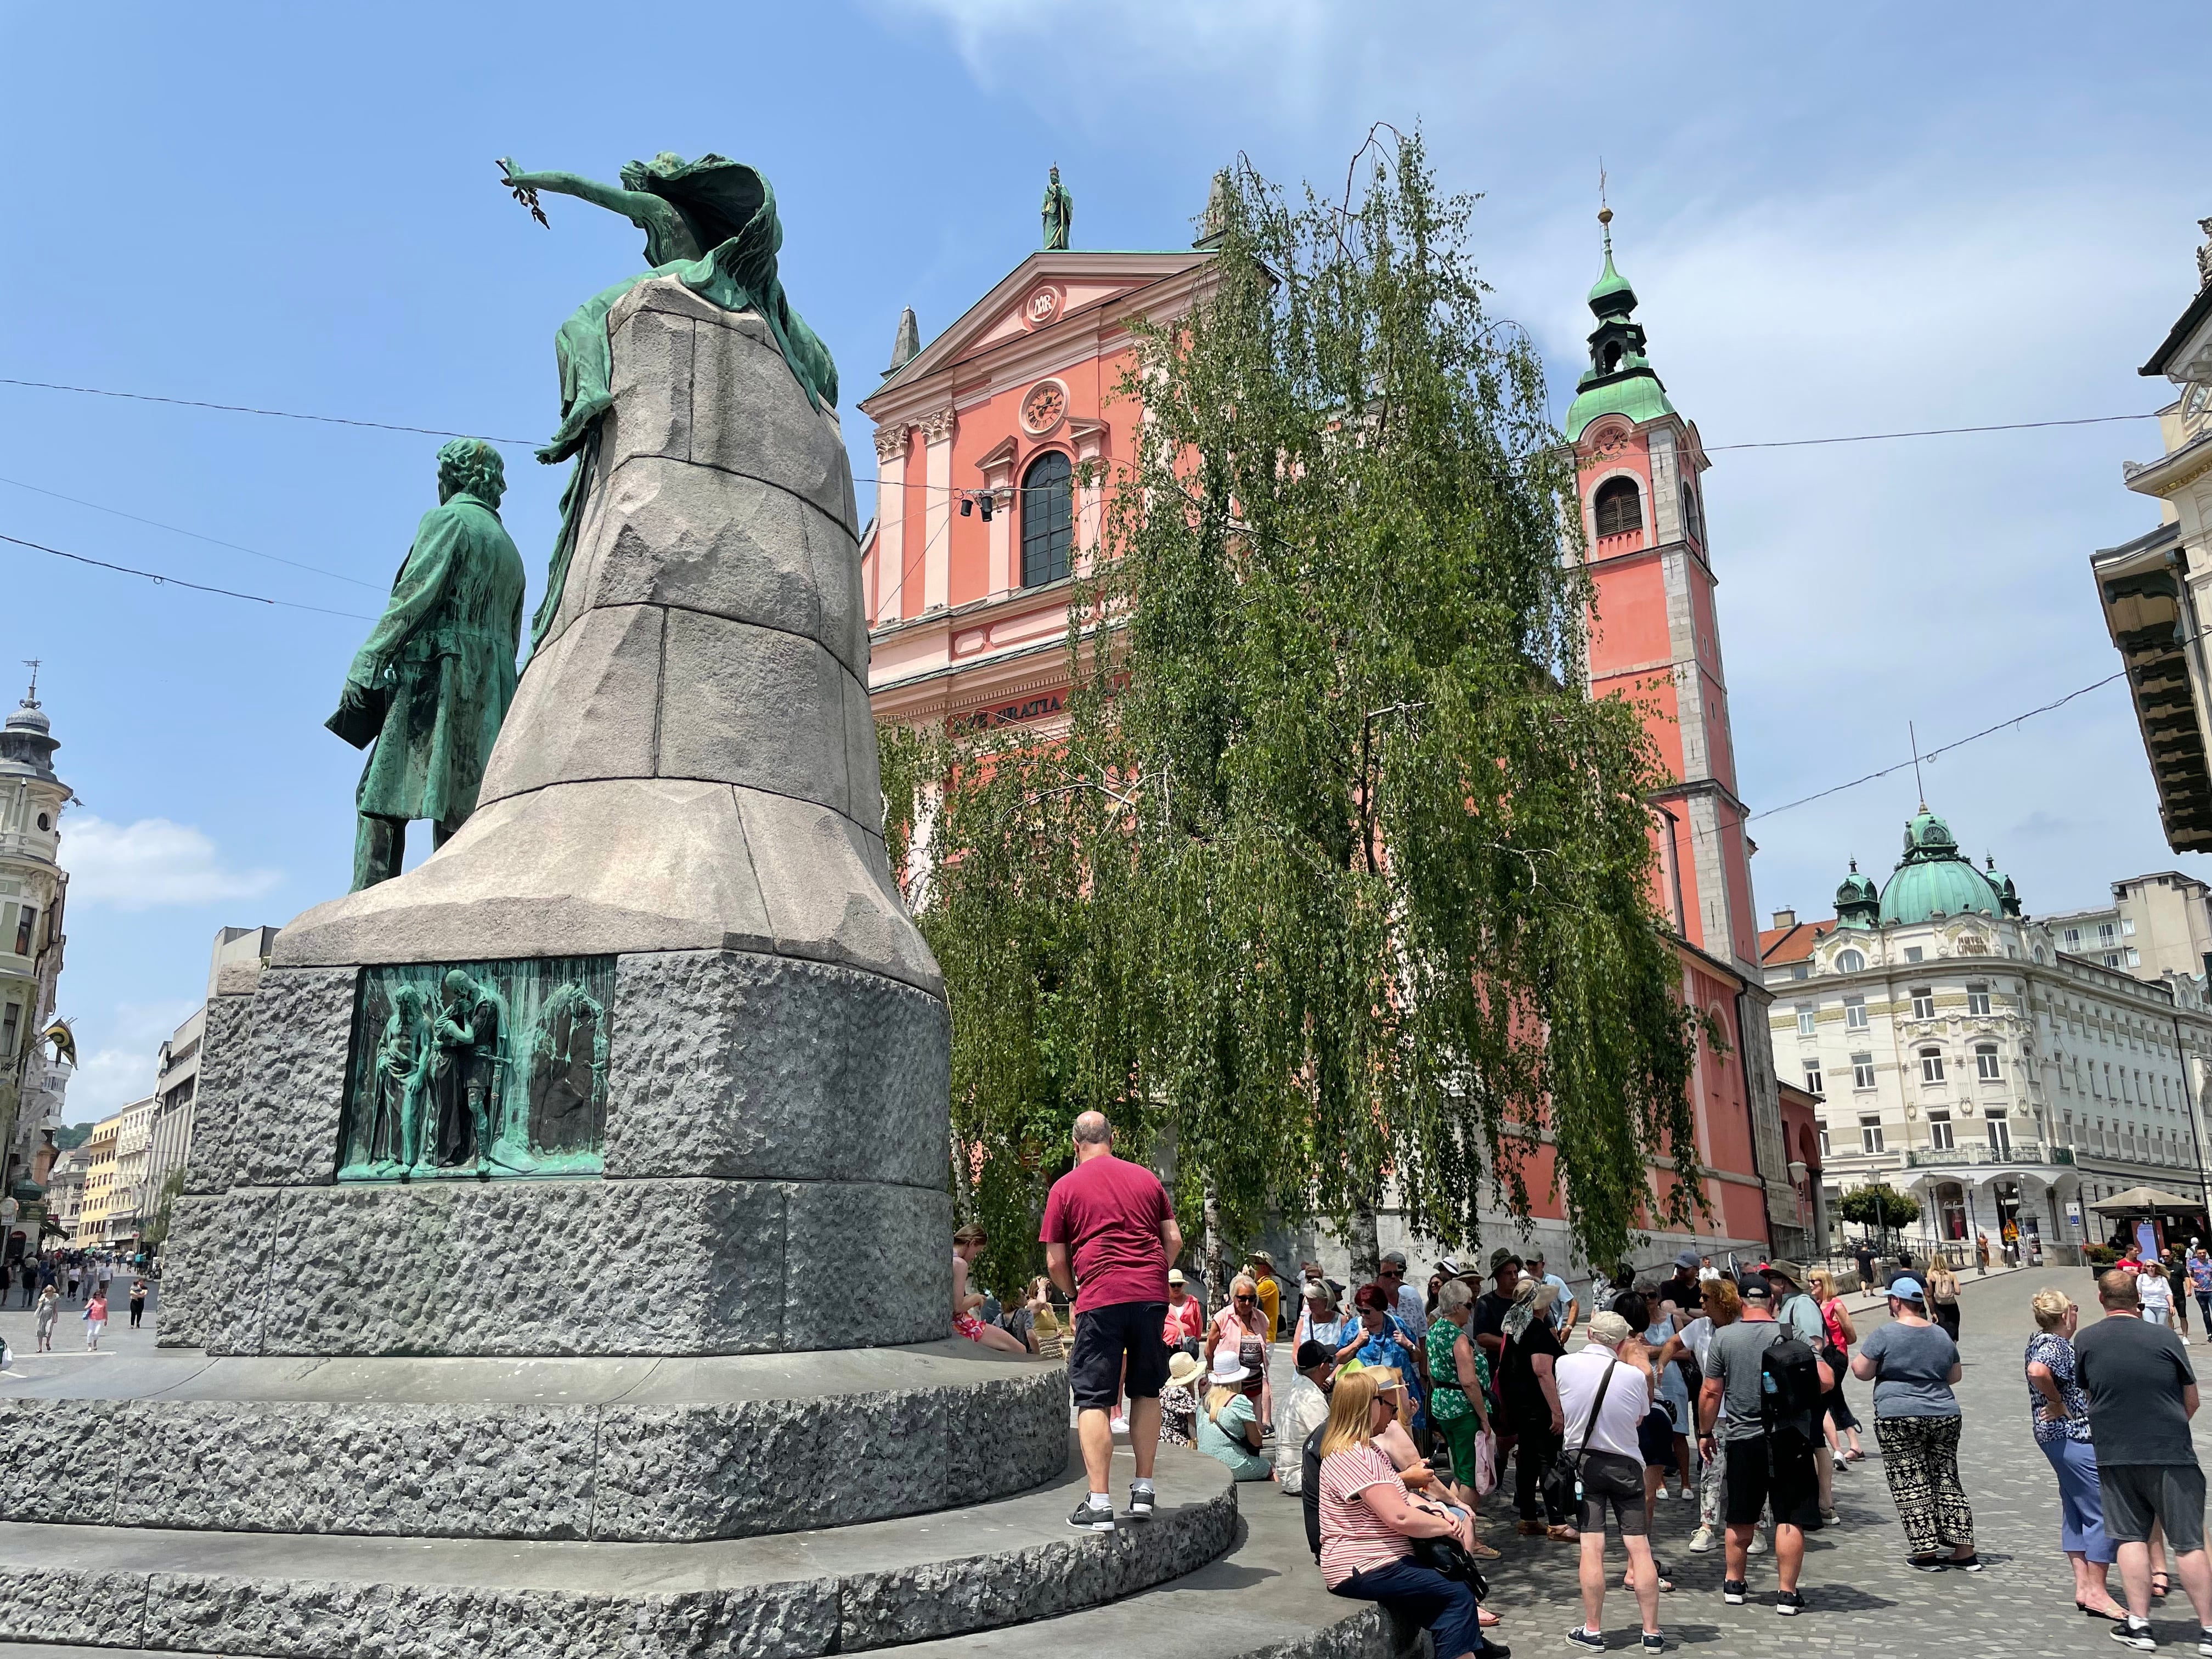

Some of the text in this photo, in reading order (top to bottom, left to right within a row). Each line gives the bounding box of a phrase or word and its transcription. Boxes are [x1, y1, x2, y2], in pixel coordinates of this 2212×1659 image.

[996, 696, 1062, 723] GRATIA
[1957, 936, 1984, 944] HOTEL
[1957, 945, 1988, 953] UNION
